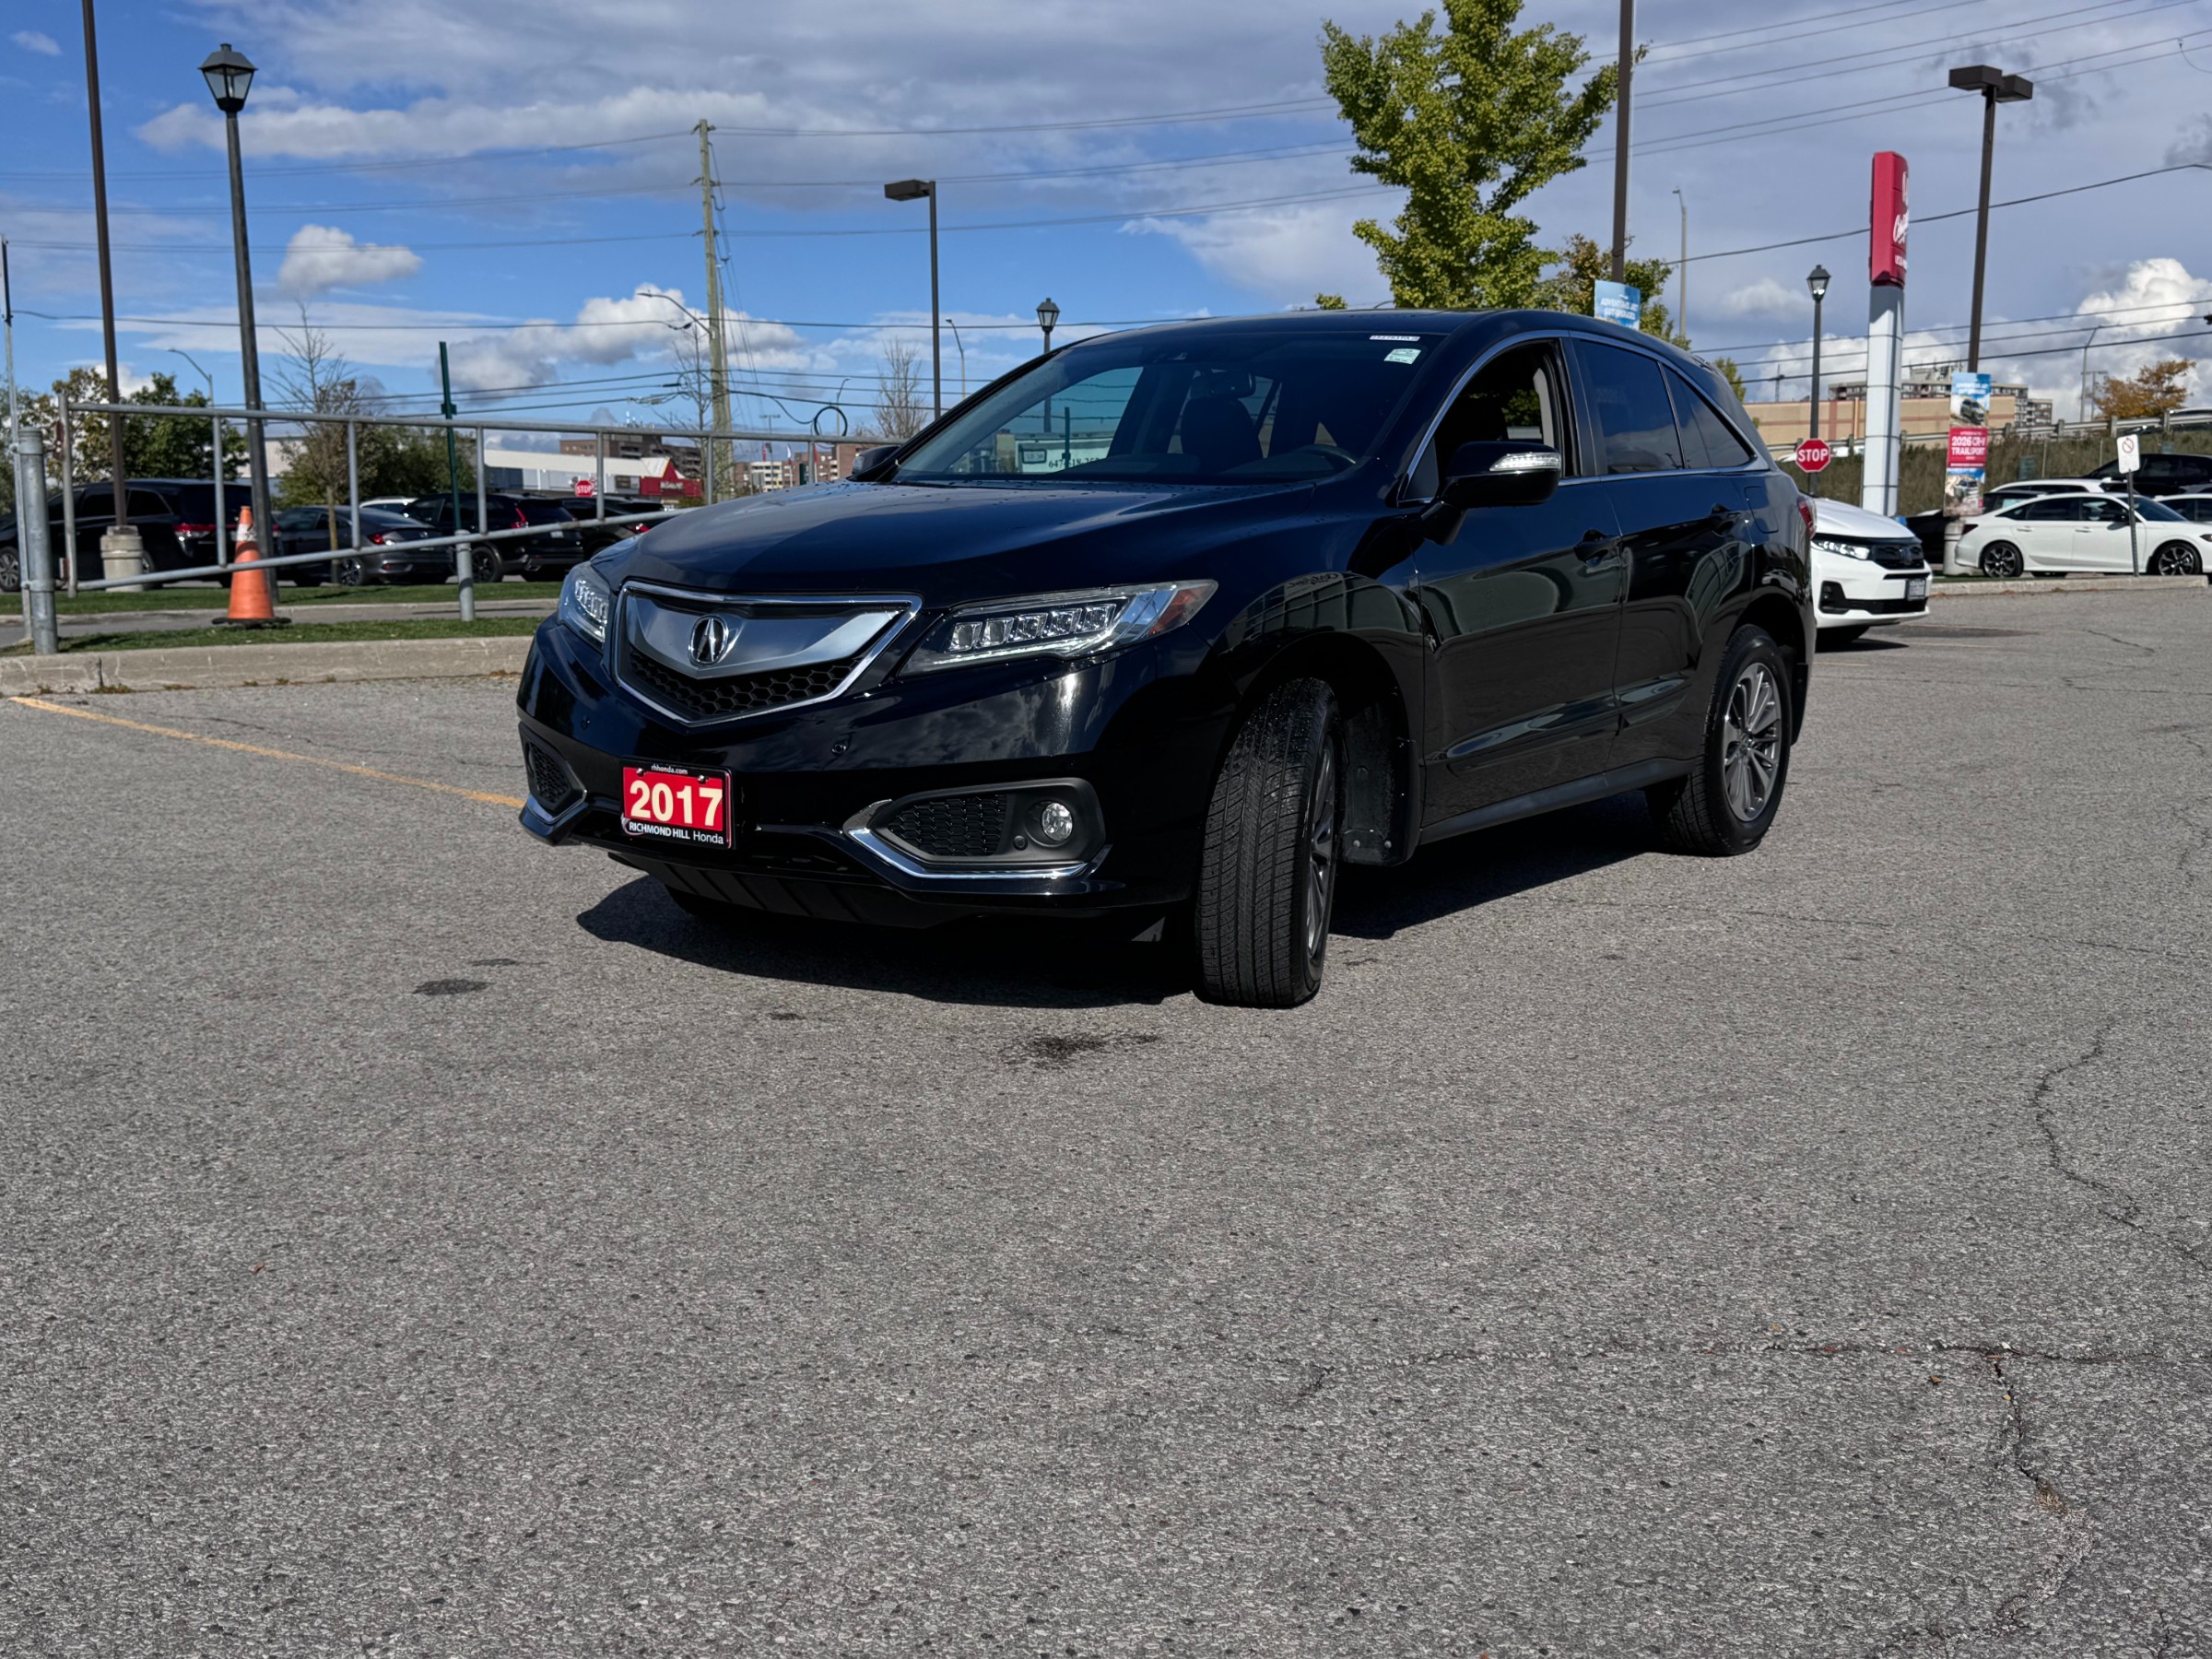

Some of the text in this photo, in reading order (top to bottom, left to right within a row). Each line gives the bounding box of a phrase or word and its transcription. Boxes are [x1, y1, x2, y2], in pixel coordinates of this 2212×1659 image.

[1951, 436, 1971, 447] 2026
[1798, 449, 1828, 463] STOP
[1951, 447, 1985, 455] TRAILSPORT
[576, 485, 592, 494] STOP
[651, 764, 688, 774] rhhonda.com
[629, 780, 723, 827] 2017
[629, 821, 724, 845] RICHMOND HILL Honda
